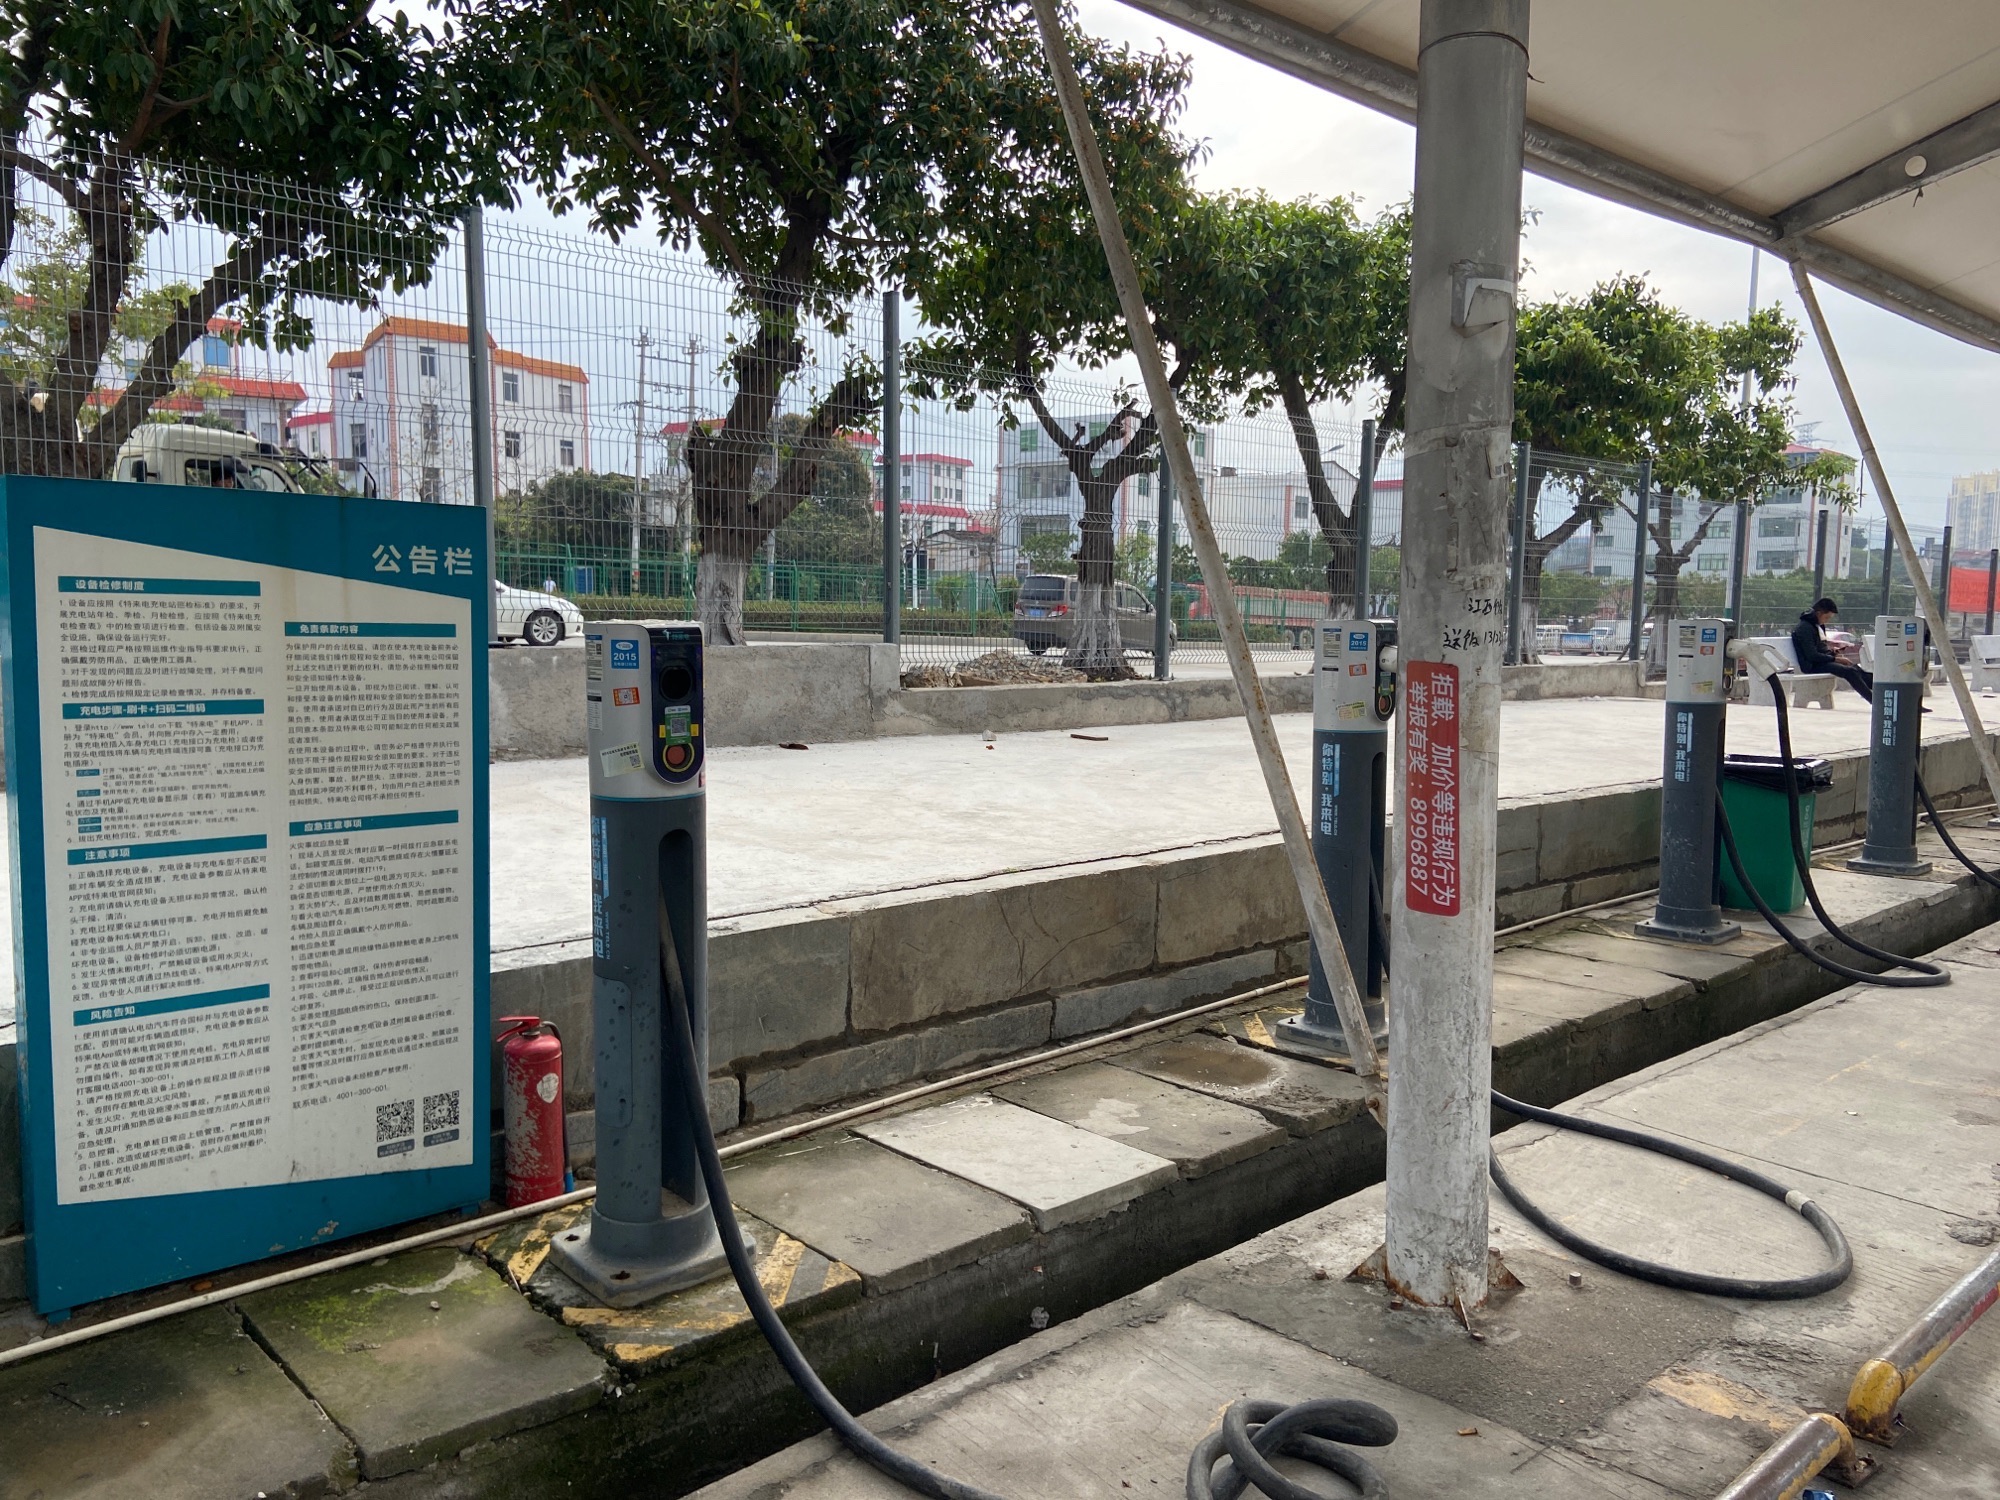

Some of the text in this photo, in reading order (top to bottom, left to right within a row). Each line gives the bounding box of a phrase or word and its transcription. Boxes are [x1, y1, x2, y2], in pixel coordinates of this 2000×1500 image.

[372, 544, 473, 576] 公告栏
[75, 578, 144, 591] 设备检修制度
[299, 623, 359, 634] 免责条款内容
[613, 652, 637, 661] 2015
[1409, 681, 1429, 896] 举报有奖：8996887
[1431, 672, 1456, 908] 拒载、加价等违规行为
[303, 818, 362, 833] 应急注意事项
[289, 838, 349, 850] 火灾事故应急处置
[84, 846, 131, 862] 注意事项
[290, 939, 336, 952] 触电应急处置
[89, 1004, 136, 1022] 风险告知
